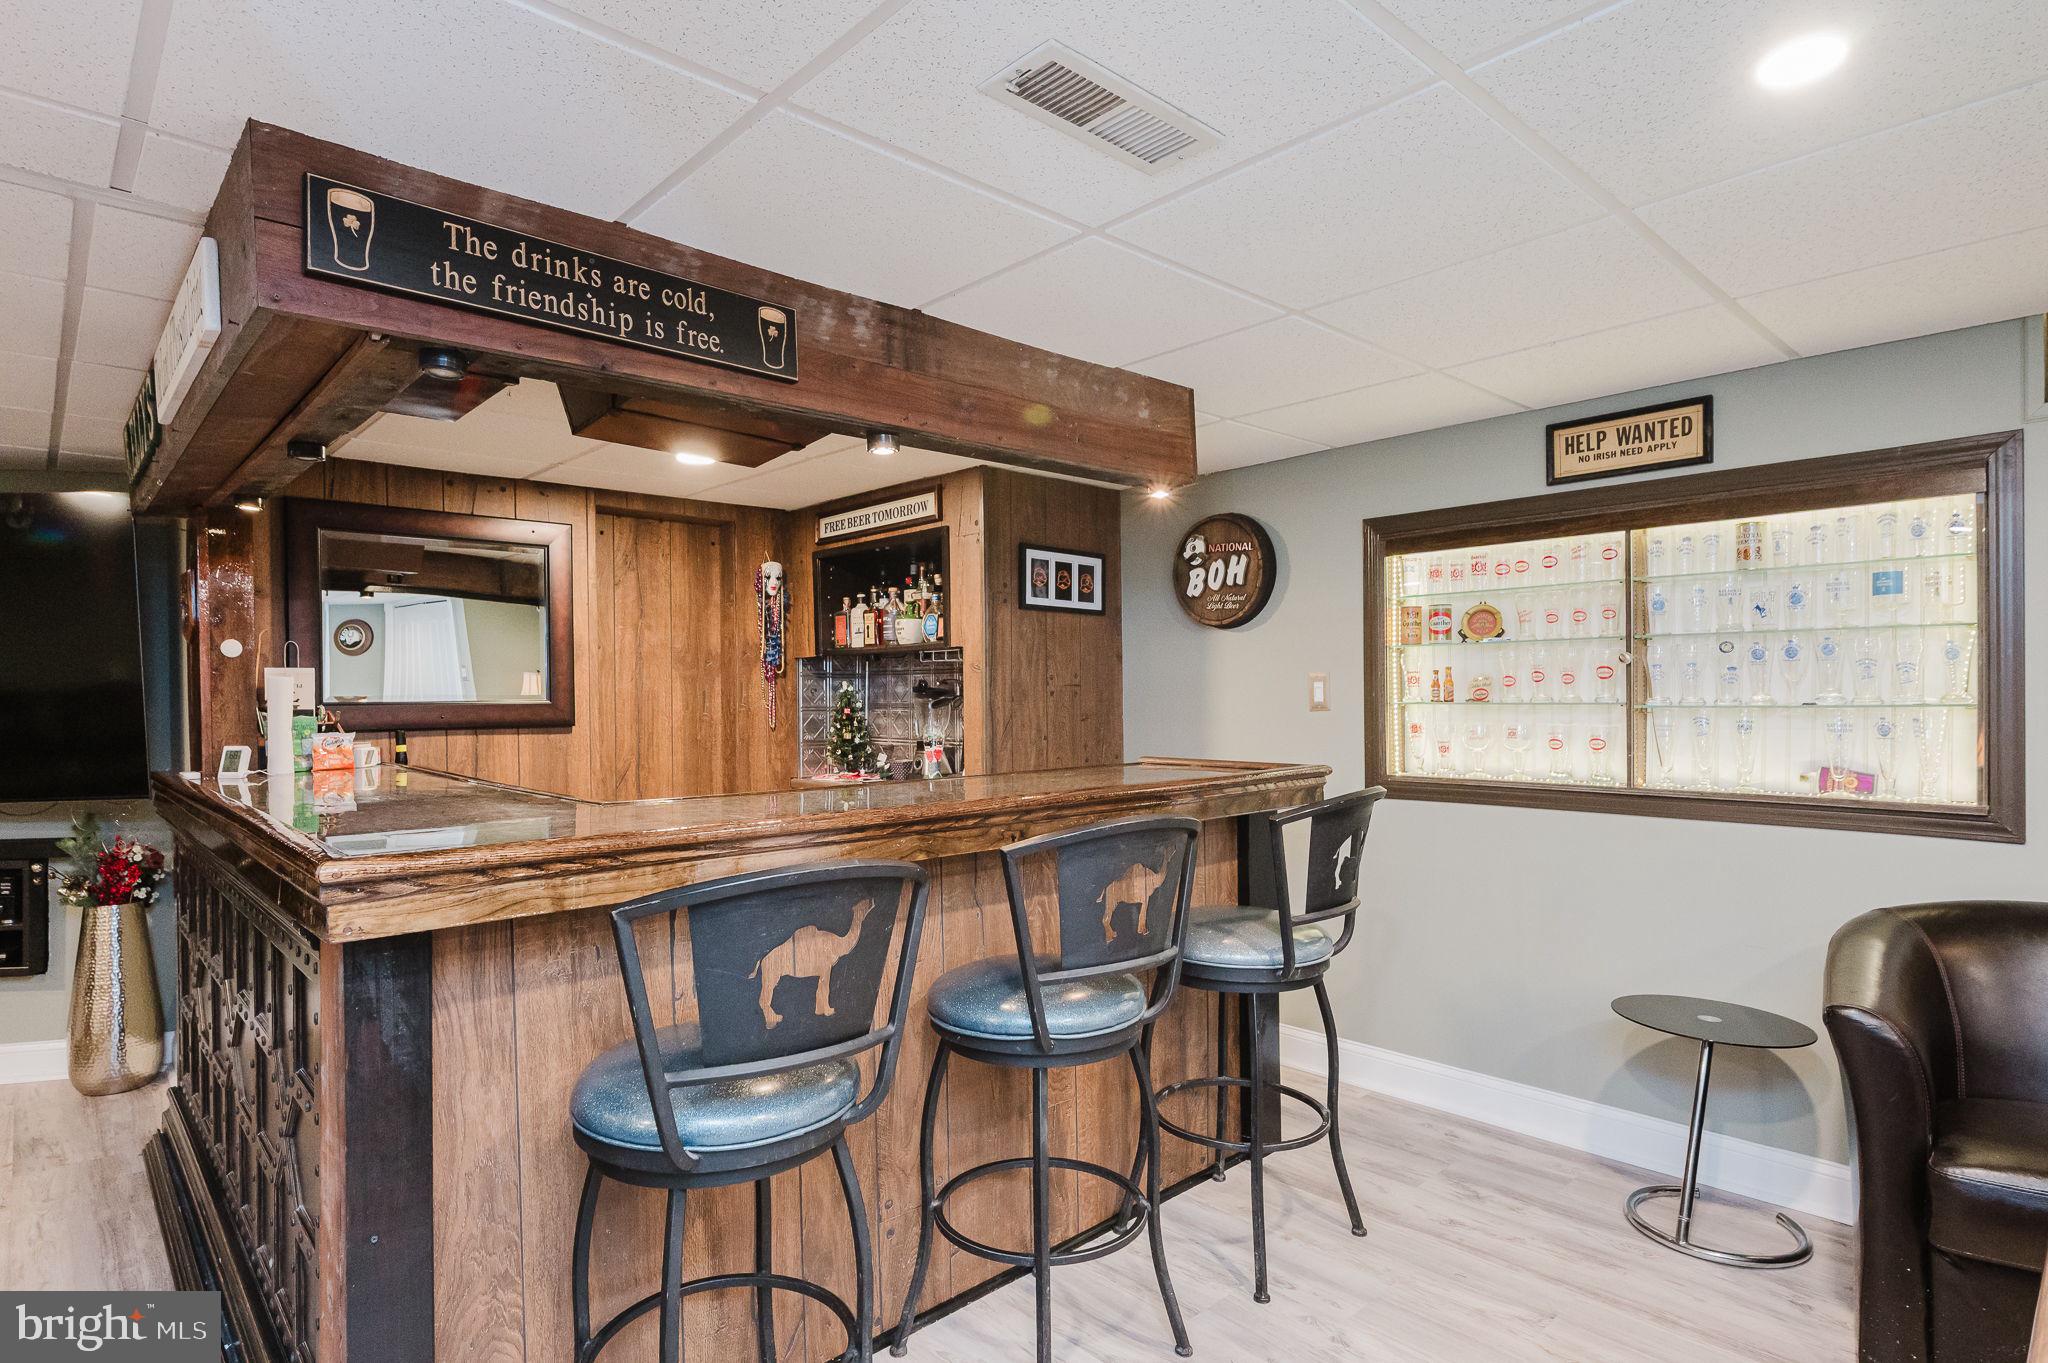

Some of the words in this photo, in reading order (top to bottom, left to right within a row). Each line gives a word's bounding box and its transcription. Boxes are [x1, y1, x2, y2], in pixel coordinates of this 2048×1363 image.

[443, 221, 498, 260] The
[511, 242, 602, 288] drinks
[613, 275, 650, 300] are
[661, 287, 715, 322] cold,
[430, 261, 477, 294] the
[492, 274, 634, 338] friendship
[645, 312, 665, 339] is
[676, 320, 724, 354] free.
[1564, 430, 1607, 455] HELP
[1616, 415, 1693, 446] WANTED
[1578, 455, 1590, 463] NO
[1593, 451, 1617, 461] IRISH
[1619, 447, 1643, 457] NEED
[1646, 440, 1678, 453] APPLY
[824, 519, 847, 534] FREE
[847, 513, 871, 529] BEER
[872, 499, 929, 524] TOMORROW
[1208, 542, 1253, 552] NATIONAL
[1186, 553, 1248, 598] BOH
